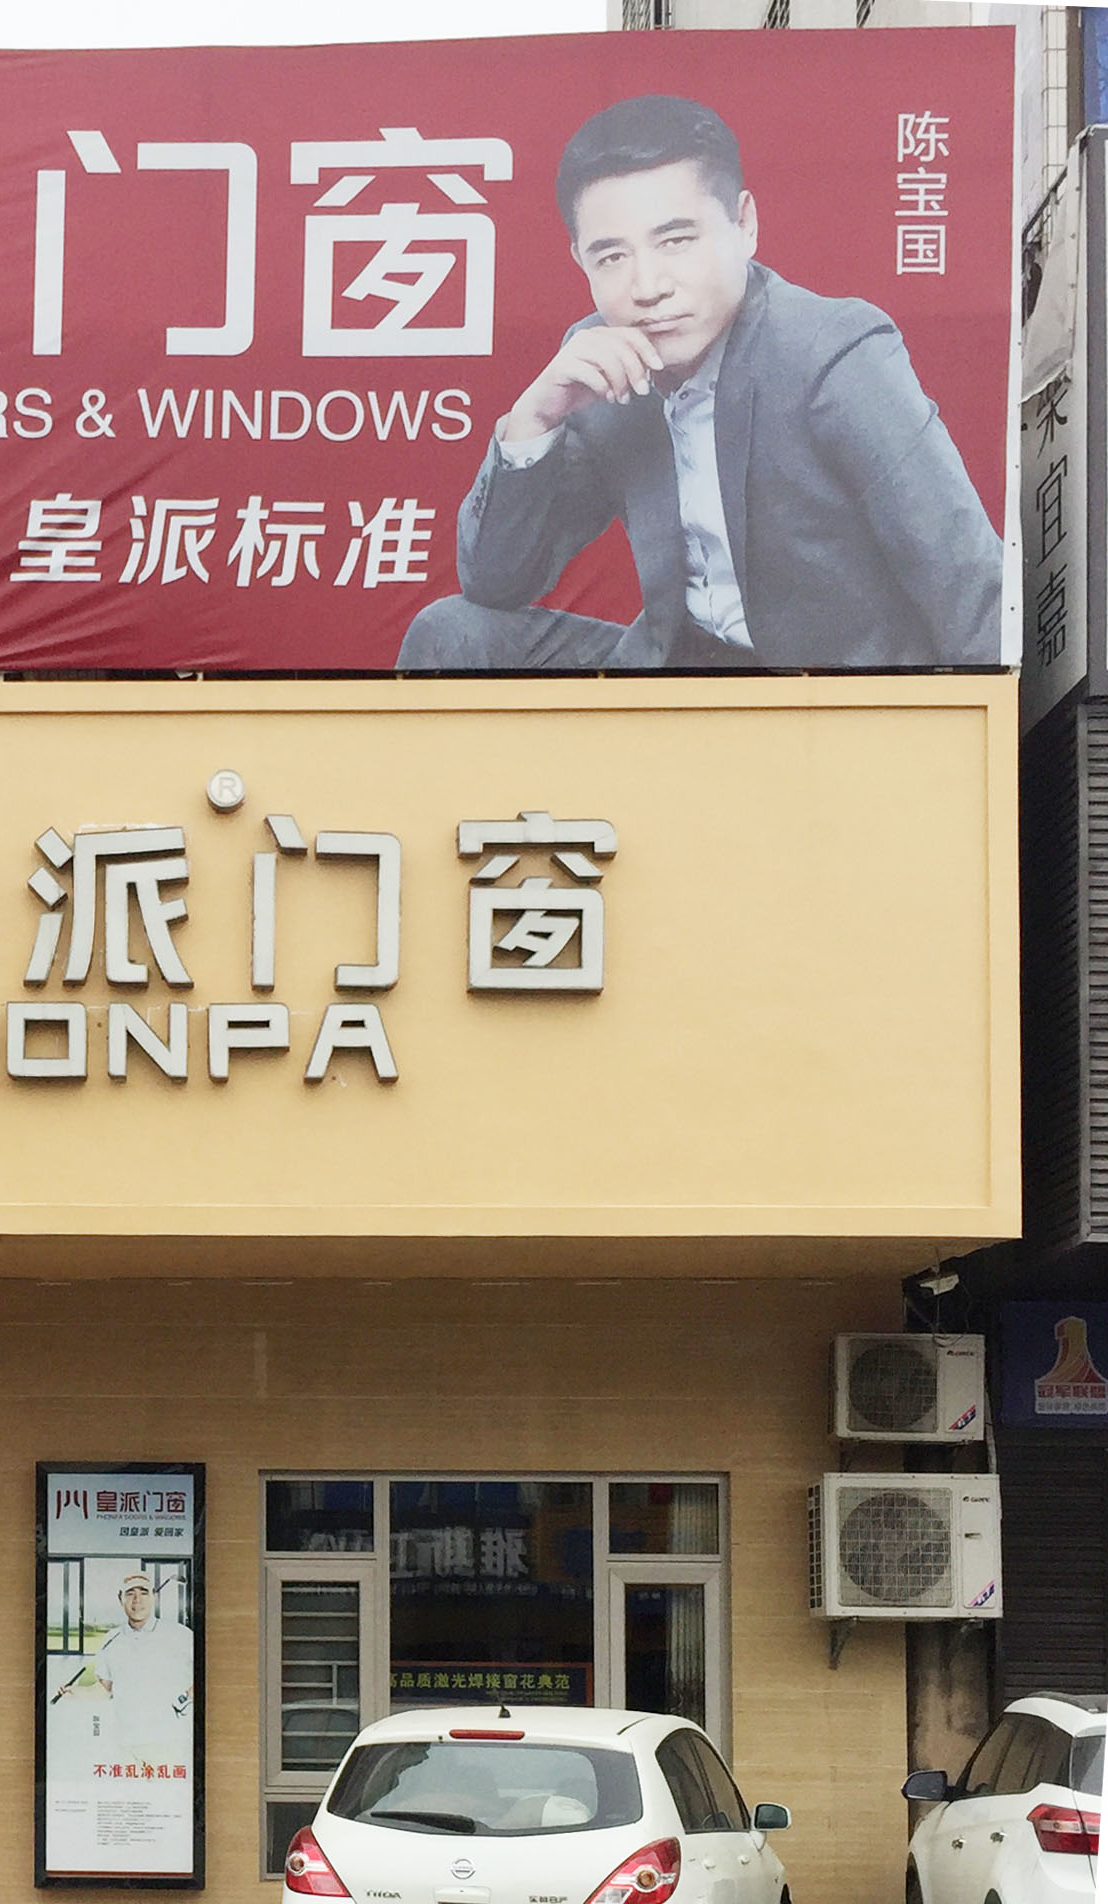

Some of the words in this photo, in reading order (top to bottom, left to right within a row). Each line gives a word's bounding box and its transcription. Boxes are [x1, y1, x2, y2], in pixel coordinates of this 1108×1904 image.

[895, 110, 950, 275] 陈宝国
[76, 388, 116, 439] &
[138, 388, 473, 442] WINDOWS
[9, 492, 437, 588] 皇派标准
[96, 1490, 187, 1513] 皇派门窗
[93, 1761, 187, 1780] 不准乱涂乱画
